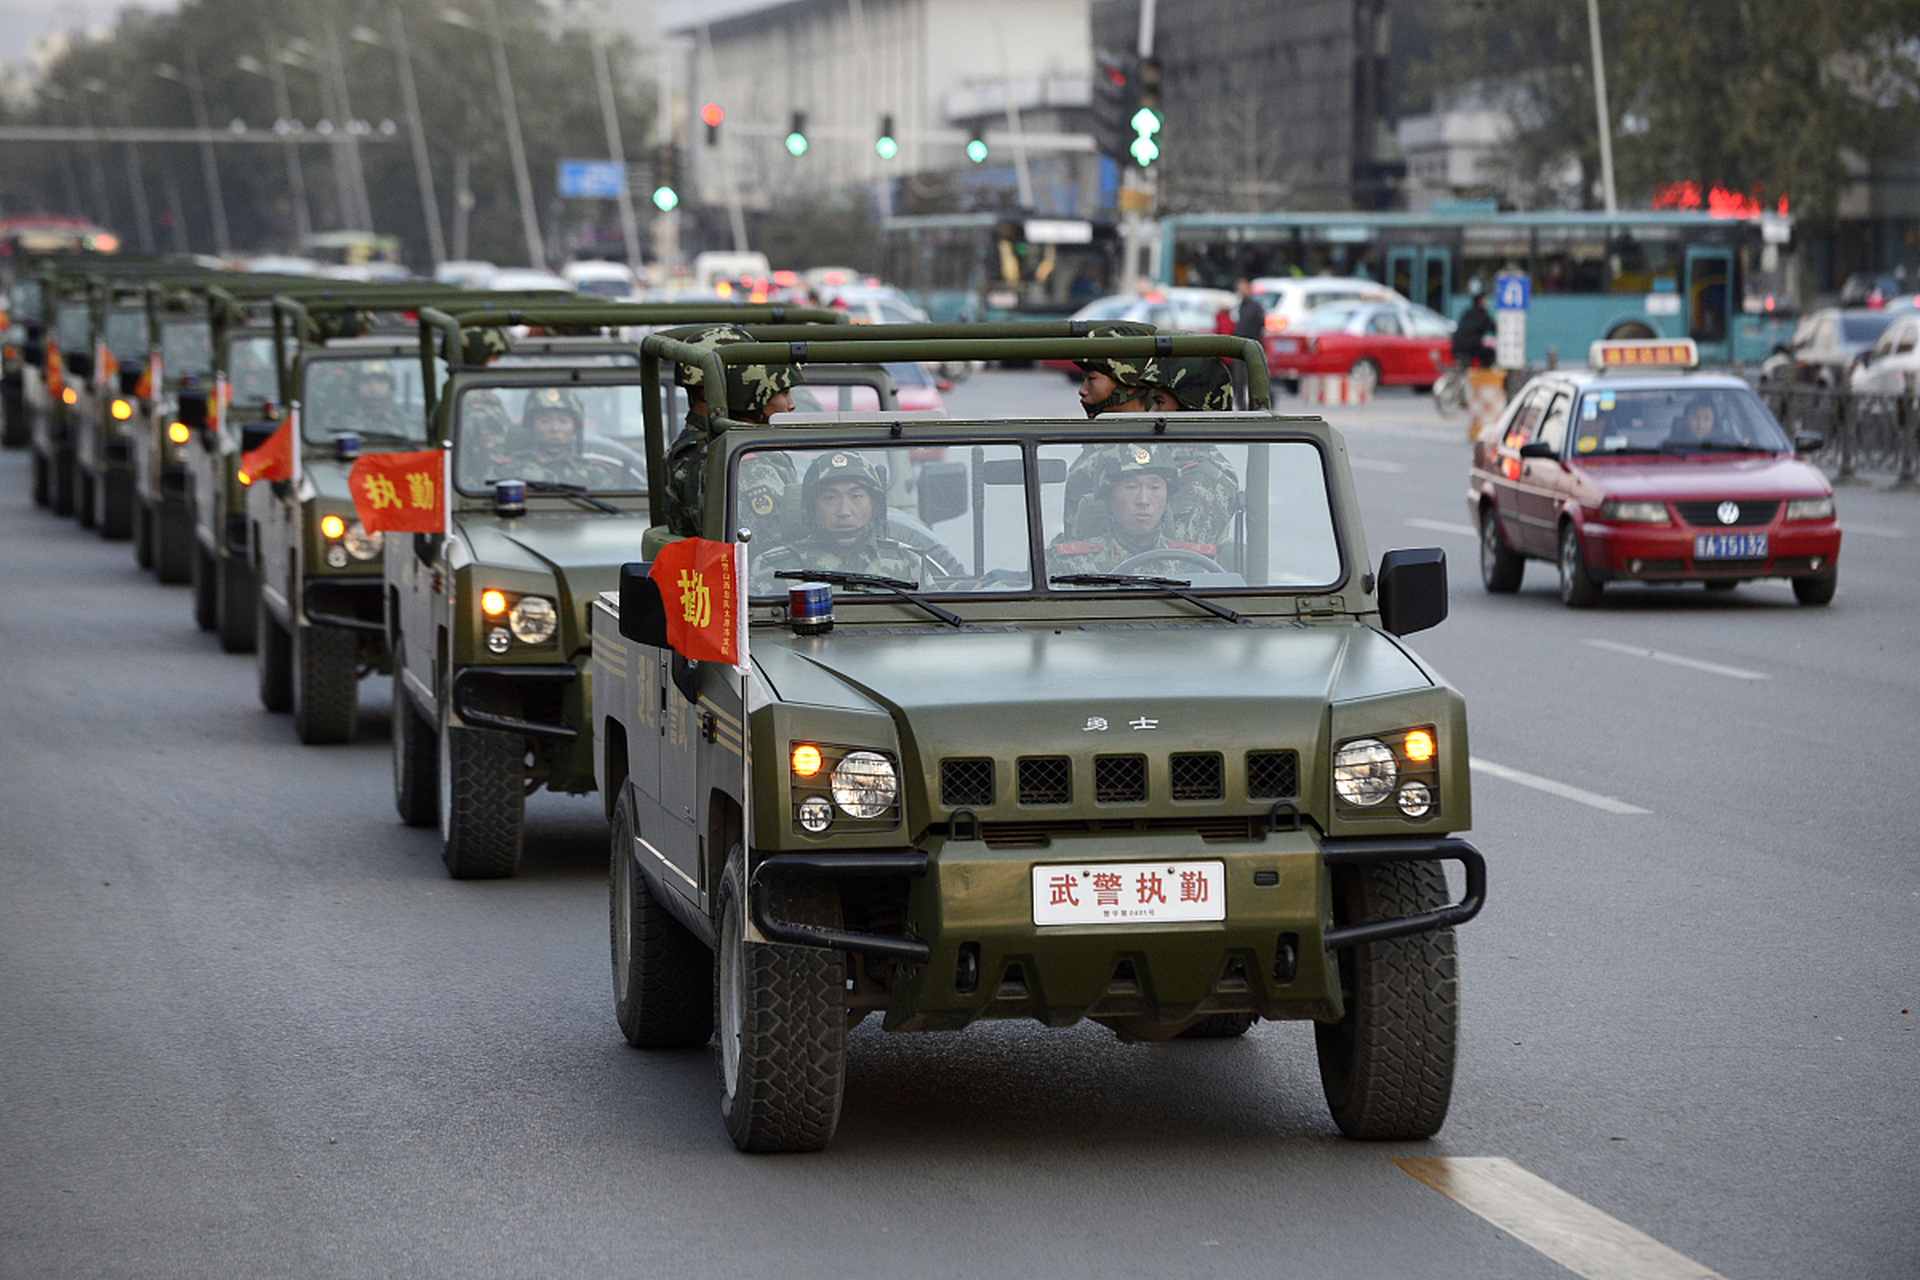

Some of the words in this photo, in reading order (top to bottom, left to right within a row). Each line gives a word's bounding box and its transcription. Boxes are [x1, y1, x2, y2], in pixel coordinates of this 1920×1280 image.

[362, 472, 434, 510] 执勤
[1082, 716, 1159, 732] 勇士
[1049, 870, 1209, 907] 武警执勤
